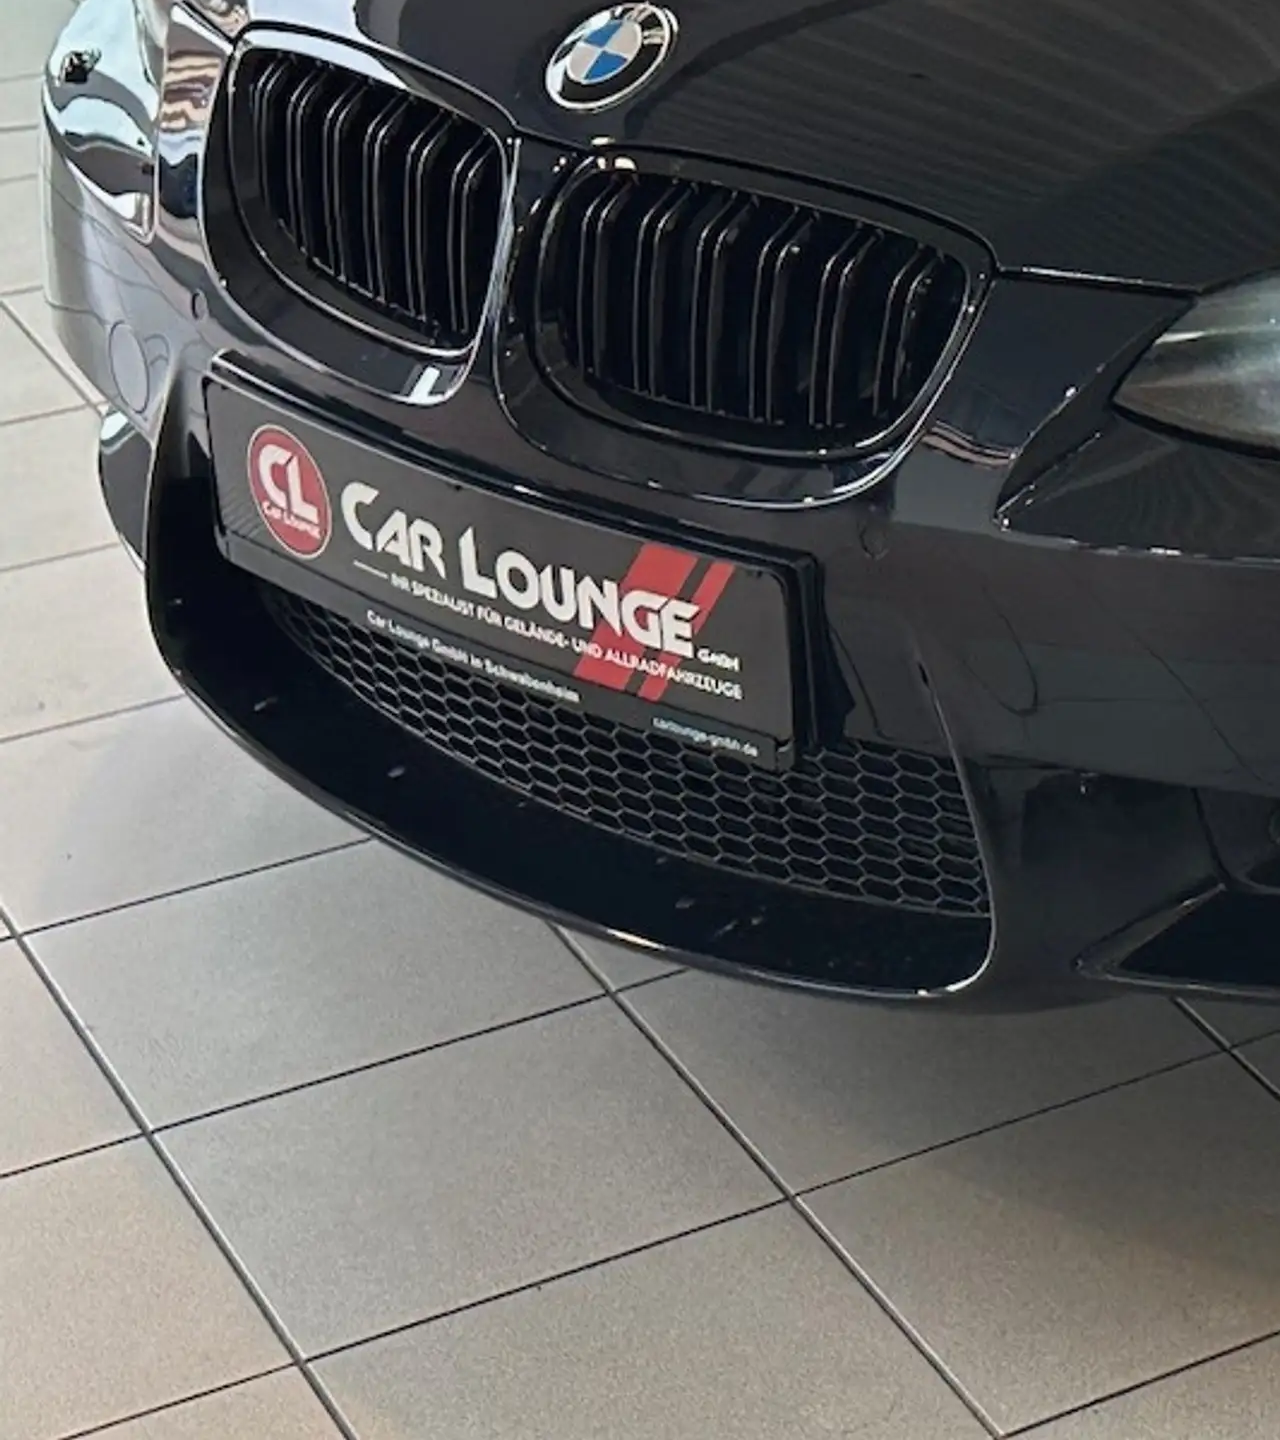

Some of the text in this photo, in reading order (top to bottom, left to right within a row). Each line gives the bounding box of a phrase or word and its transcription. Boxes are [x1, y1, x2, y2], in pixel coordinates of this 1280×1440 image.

[259, 444, 319, 525] CL
[341, 481, 447, 580] CAR
[458, 525, 700, 658] LOUNGE
[366, 609, 387, 629] Car
[388, 619, 430, 650] Lounge
[430, 638, 469, 664] GmbH
[411, 580, 475, 617] SPEZIALIST
[476, 604, 502, 628] FÜR
[504, 614, 570, 648] GELÄNDE-
[571, 636, 603, 660] UND
[603, 648, 744, 701] ALLRADFAHRZEUGE
